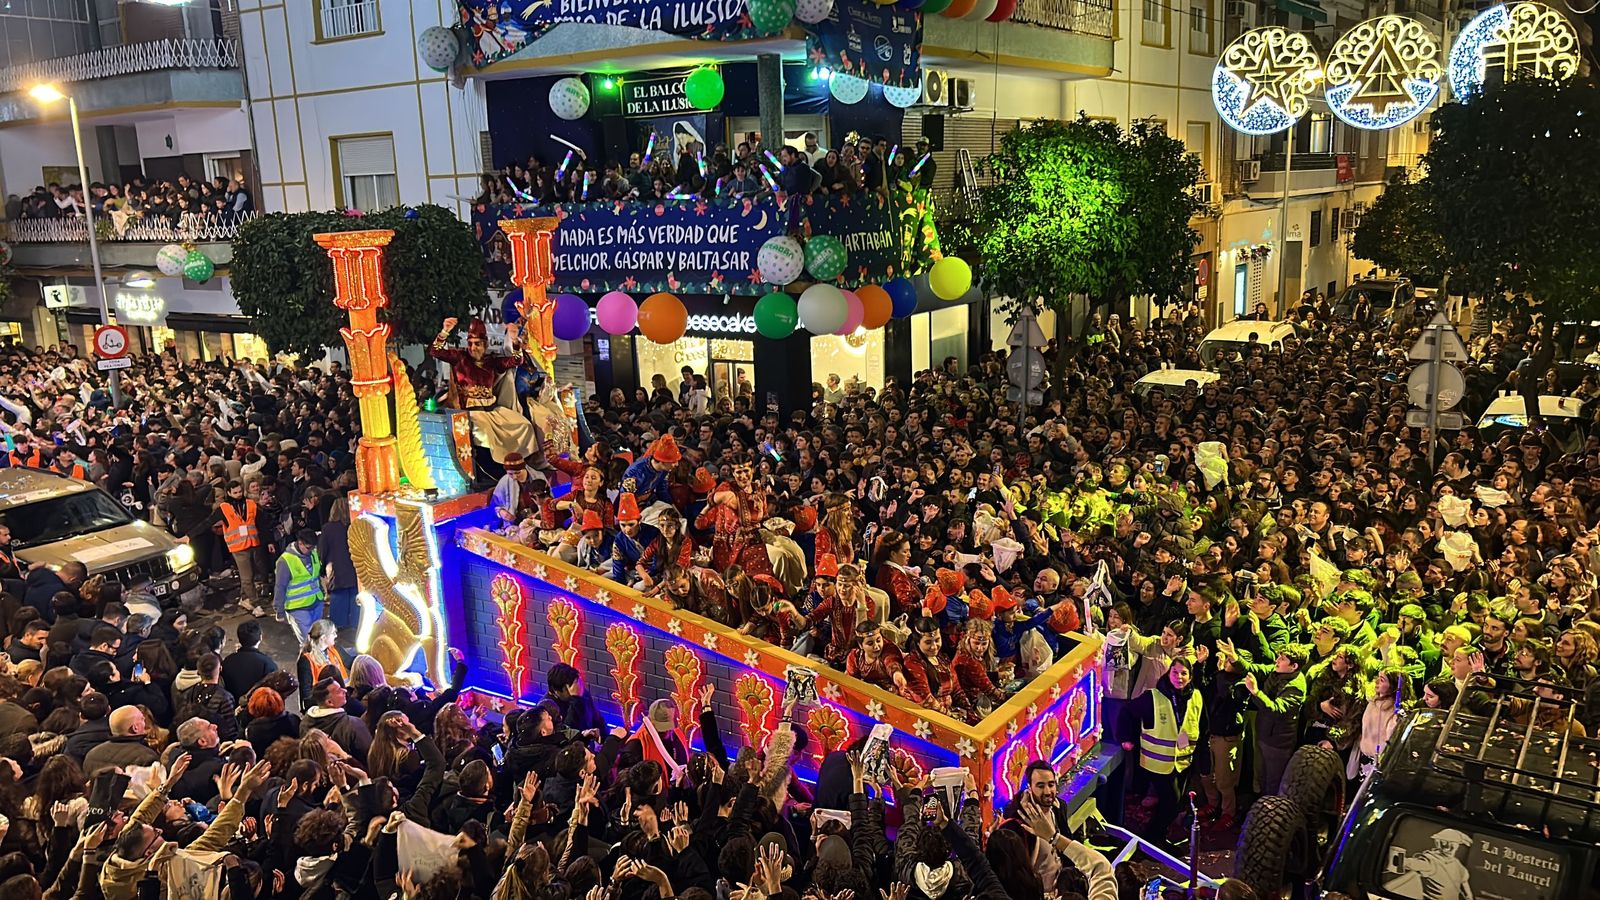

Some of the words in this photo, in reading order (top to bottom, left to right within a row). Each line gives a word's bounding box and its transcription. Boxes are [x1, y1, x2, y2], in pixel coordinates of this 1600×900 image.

[633, 86, 648, 98] EL
[627, 102, 642, 114] DE
[644, 100, 660, 112] LA
[560, 228, 595, 247] NADA
[598, 227, 614, 245] ES
[617, 219, 645, 244] MÁS
[649, 224, 704, 245] VERDAD
[707, 224, 740, 245] QUE
[614, 250, 664, 271] GASPAR
[667, 250, 676, 270] Y
[678, 251, 750, 271] BALTASAR
[1481, 841, 1499, 855] La
[1483, 860, 1502, 874] del
[1507, 864, 1551, 887] Laurel
